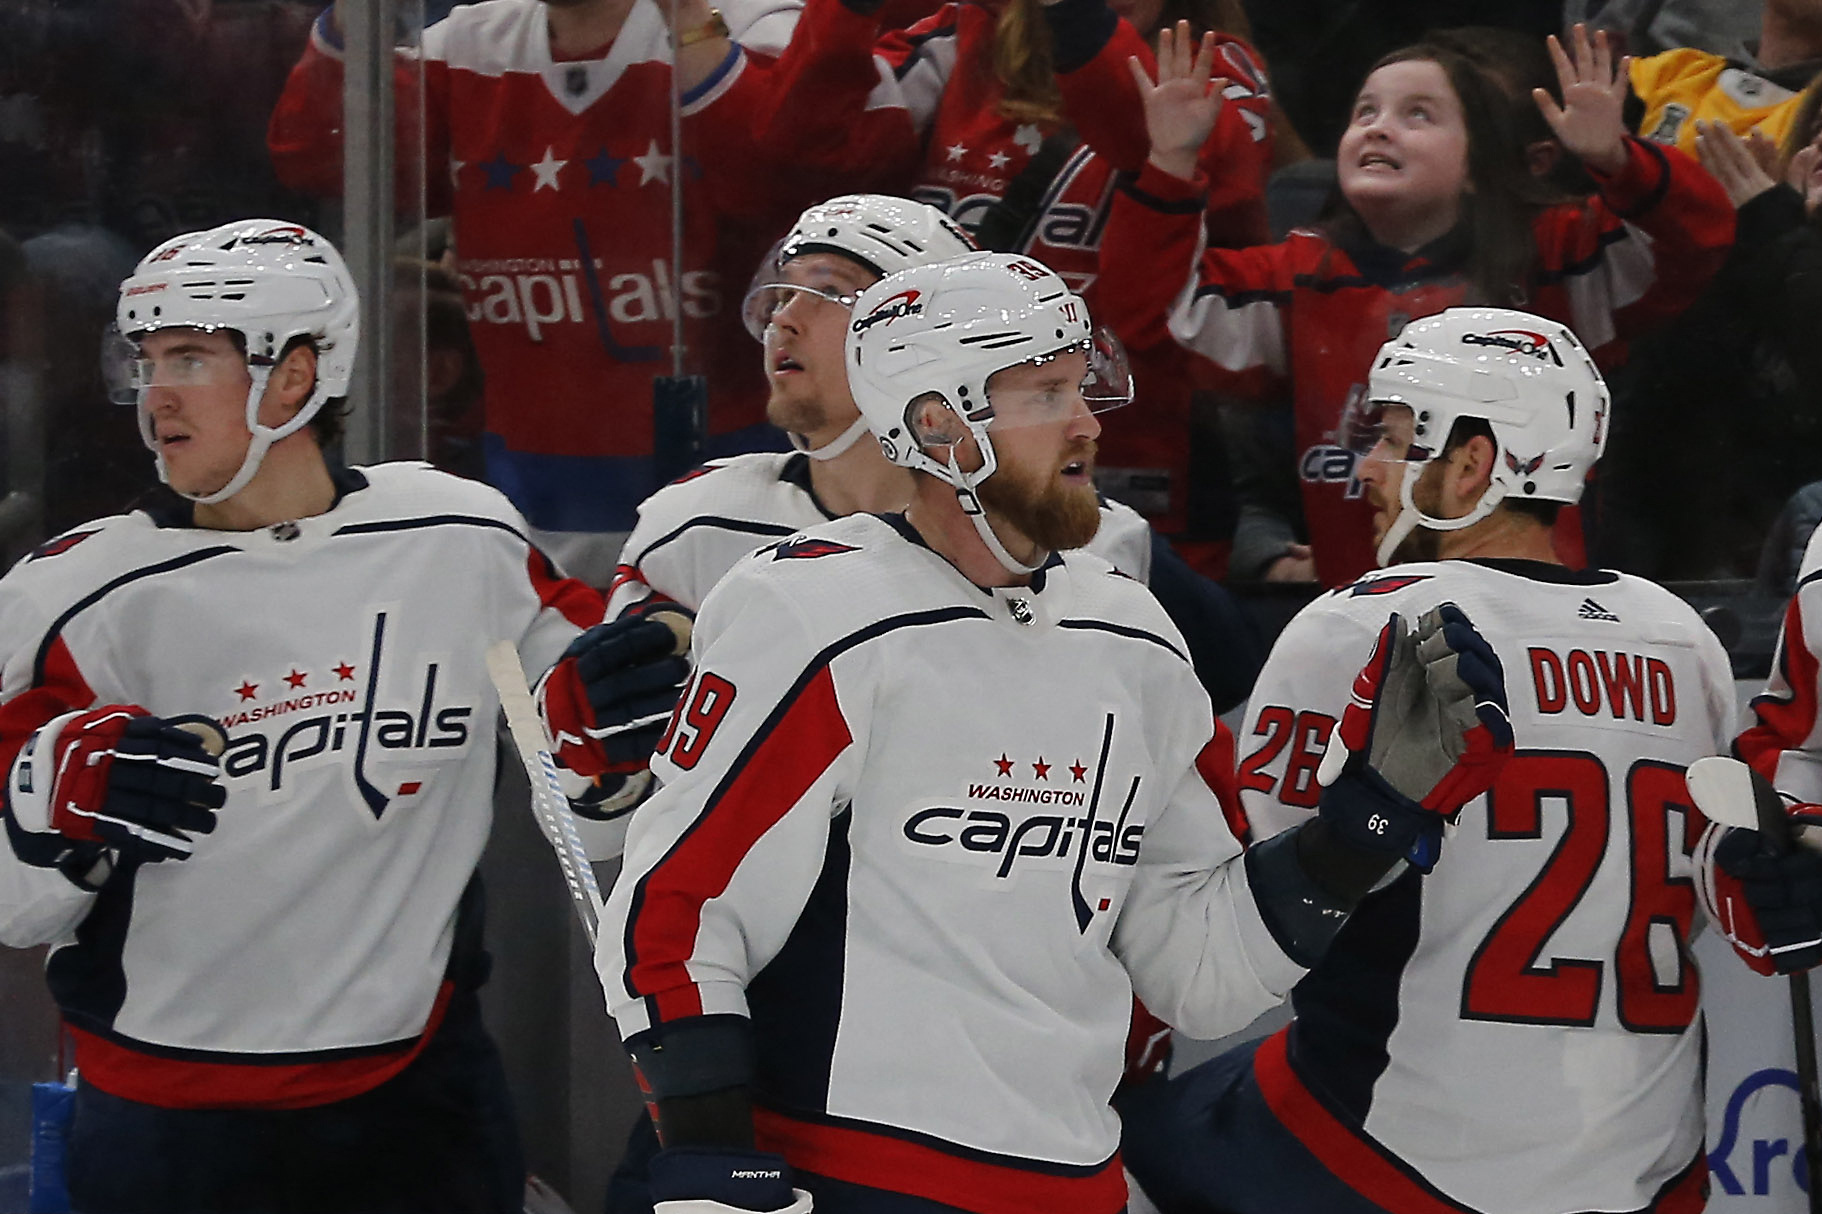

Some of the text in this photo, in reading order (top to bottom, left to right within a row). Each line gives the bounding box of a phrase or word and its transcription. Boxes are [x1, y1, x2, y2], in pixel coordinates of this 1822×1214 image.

[215, 689, 357, 729] WASHINGTON
[1527, 646, 1676, 727] DOWD
[1238, 705, 1341, 809] 26
[967, 783, 1085, 807] WASHINGTON
[1459, 748, 1701, 1035] 26
[730, 1170, 781, 1180] MANTHA
